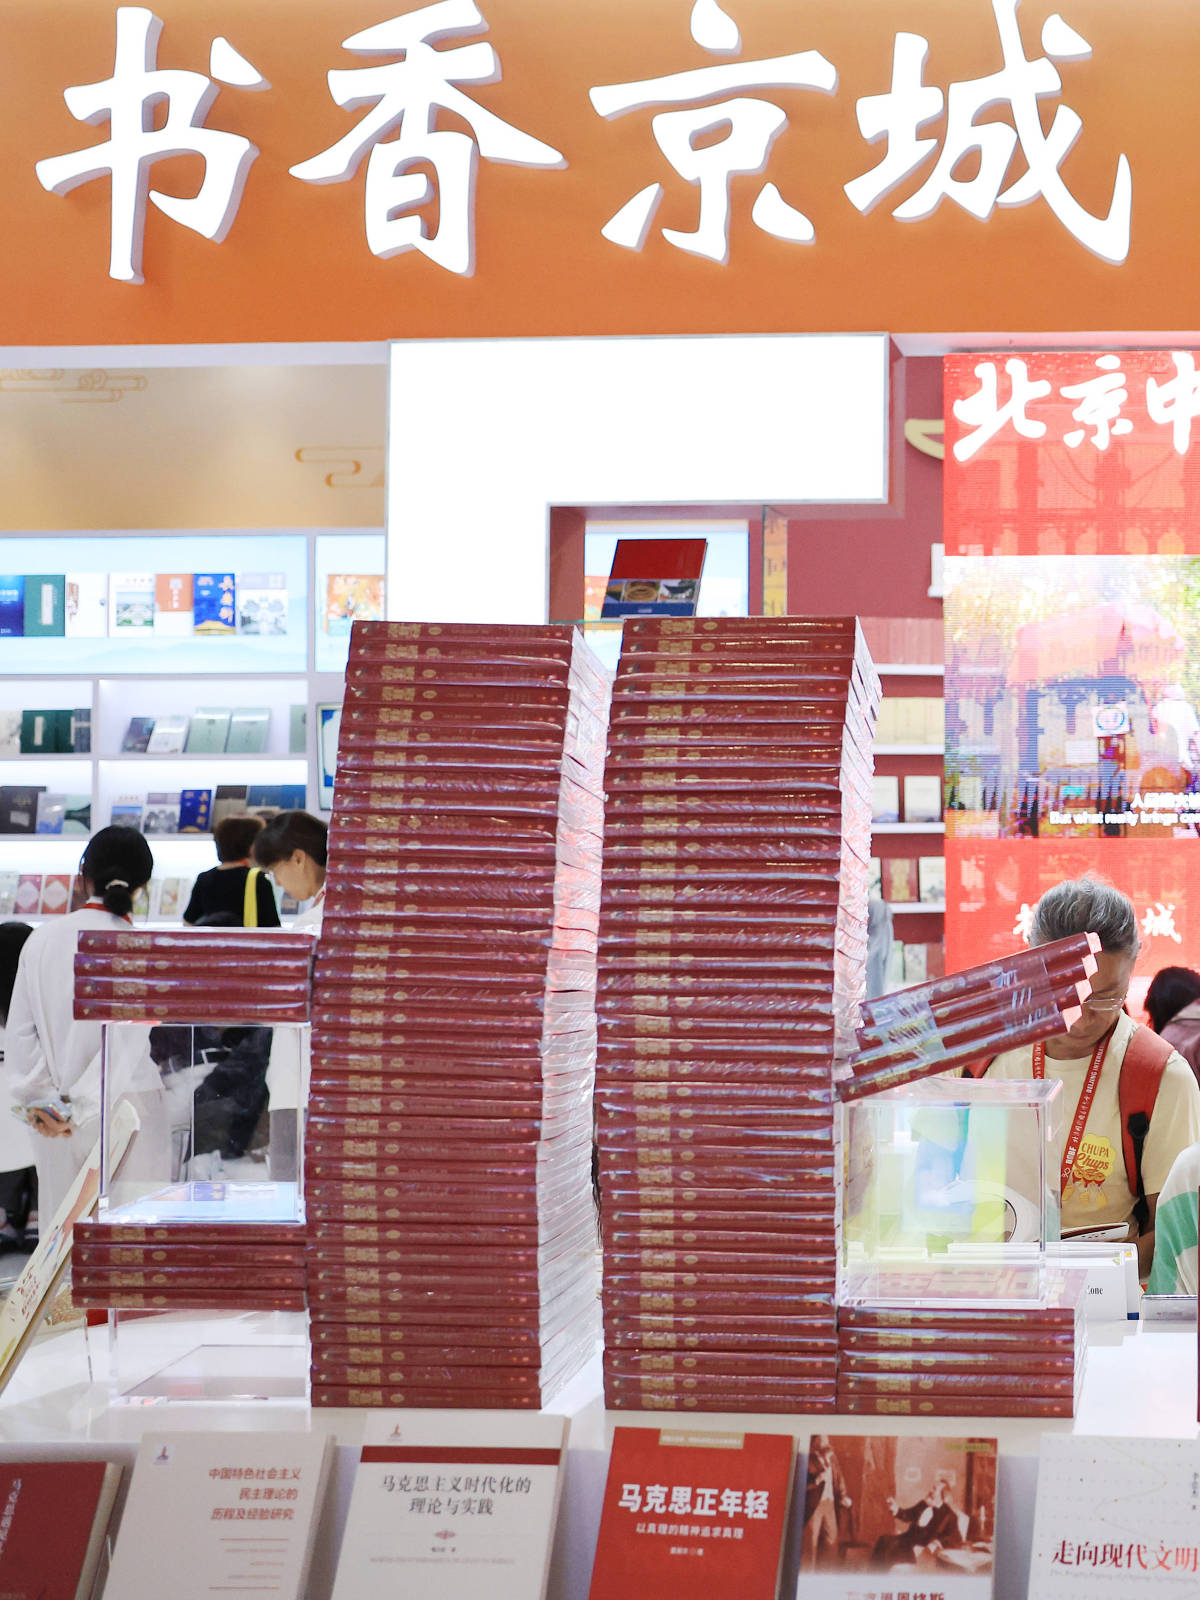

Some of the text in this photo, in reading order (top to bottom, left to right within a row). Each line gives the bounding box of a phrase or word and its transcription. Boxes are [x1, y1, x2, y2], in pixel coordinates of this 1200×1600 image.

[36, 0, 1131, 283] 书香京城
[1081, 1142, 1109, 1157] CHUPA
[1077, 1153, 1110, 1171] Chups
[208, 1467, 302, 1481] 中国特色社会主义
[383, 1474, 532, 1494] 马克思主义时代化的
[239, 1487, 298, 1501] 民主理论的
[618, 1483, 770, 1520] 马克思正年轻
[409, 1497, 494, 1516] 理论与实践
[1051, 1540, 1199, 1573] 走向现代文明
